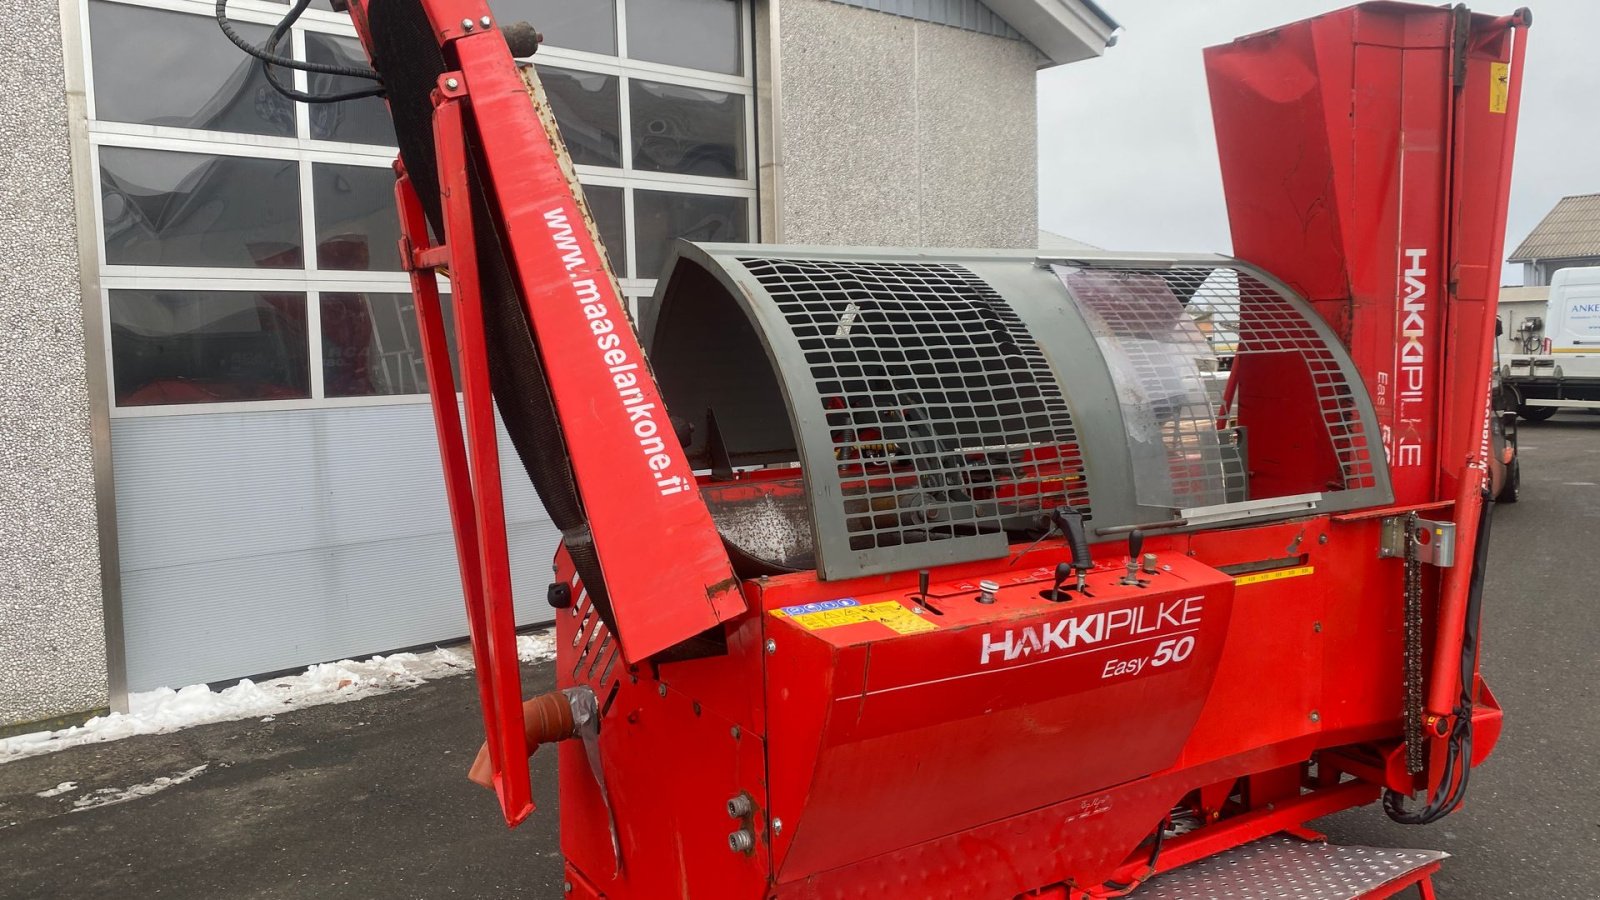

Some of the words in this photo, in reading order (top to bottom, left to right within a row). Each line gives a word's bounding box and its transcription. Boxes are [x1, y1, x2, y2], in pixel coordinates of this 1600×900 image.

[543, 207, 690, 496] www.maaselankone.fi
[1400, 248, 1428, 466] HAKKIPILKE
[1377, 371, 1389, 407] Eas
[979, 595, 1205, 665] HAKKIPILKE
[1101, 655, 1149, 679] Easy
[1151, 635, 1195, 667] 50
